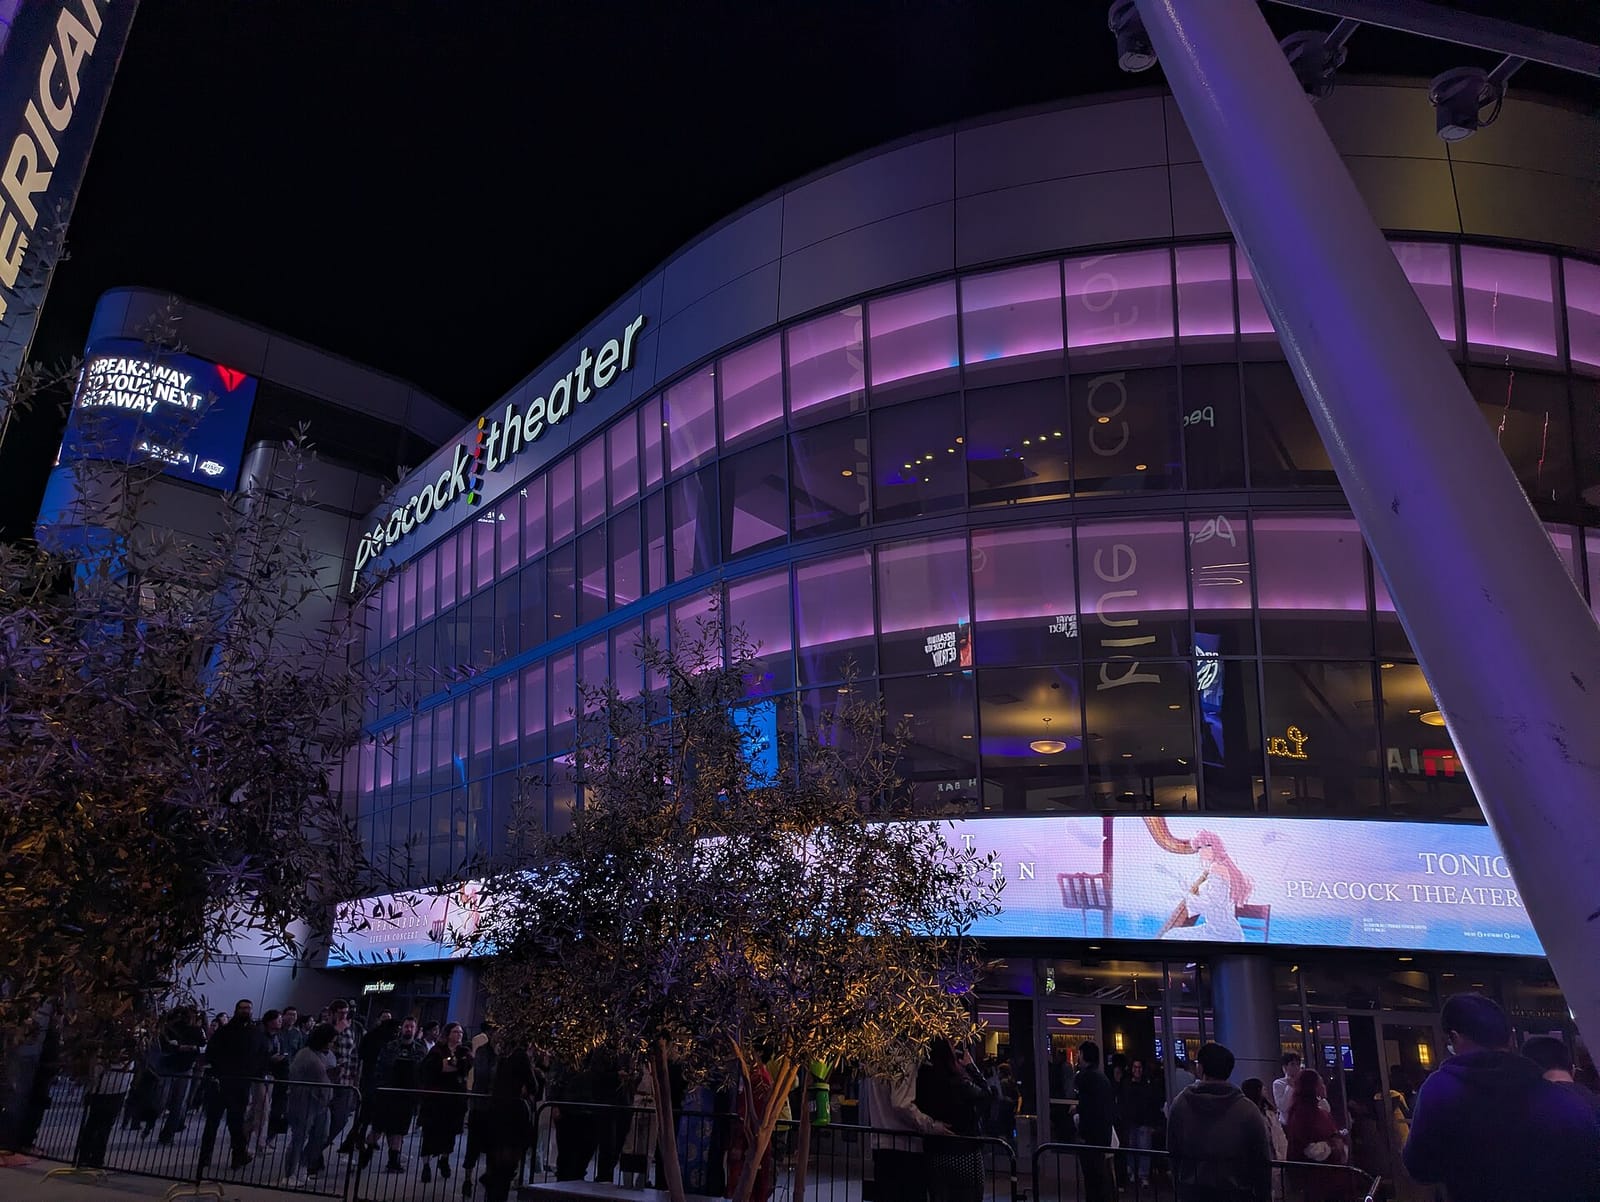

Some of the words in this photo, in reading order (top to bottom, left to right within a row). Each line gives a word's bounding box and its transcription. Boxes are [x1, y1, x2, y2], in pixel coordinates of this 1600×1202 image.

[0, 0, 103, 320] ERICA
[89, 358, 192, 389] BREAKAWAY
[106, 374, 153, 396] YOUR
[155, 385, 203, 411] NEXT
[151, 445, 190, 463] DETA
[350, 443, 472, 594] peacock
[485, 314, 645, 472] theater
[1418, 851, 1512, 879] TONIG
[1285, 879, 1402, 903] PEACOCK
[1407, 883, 1522, 908] THEATER
